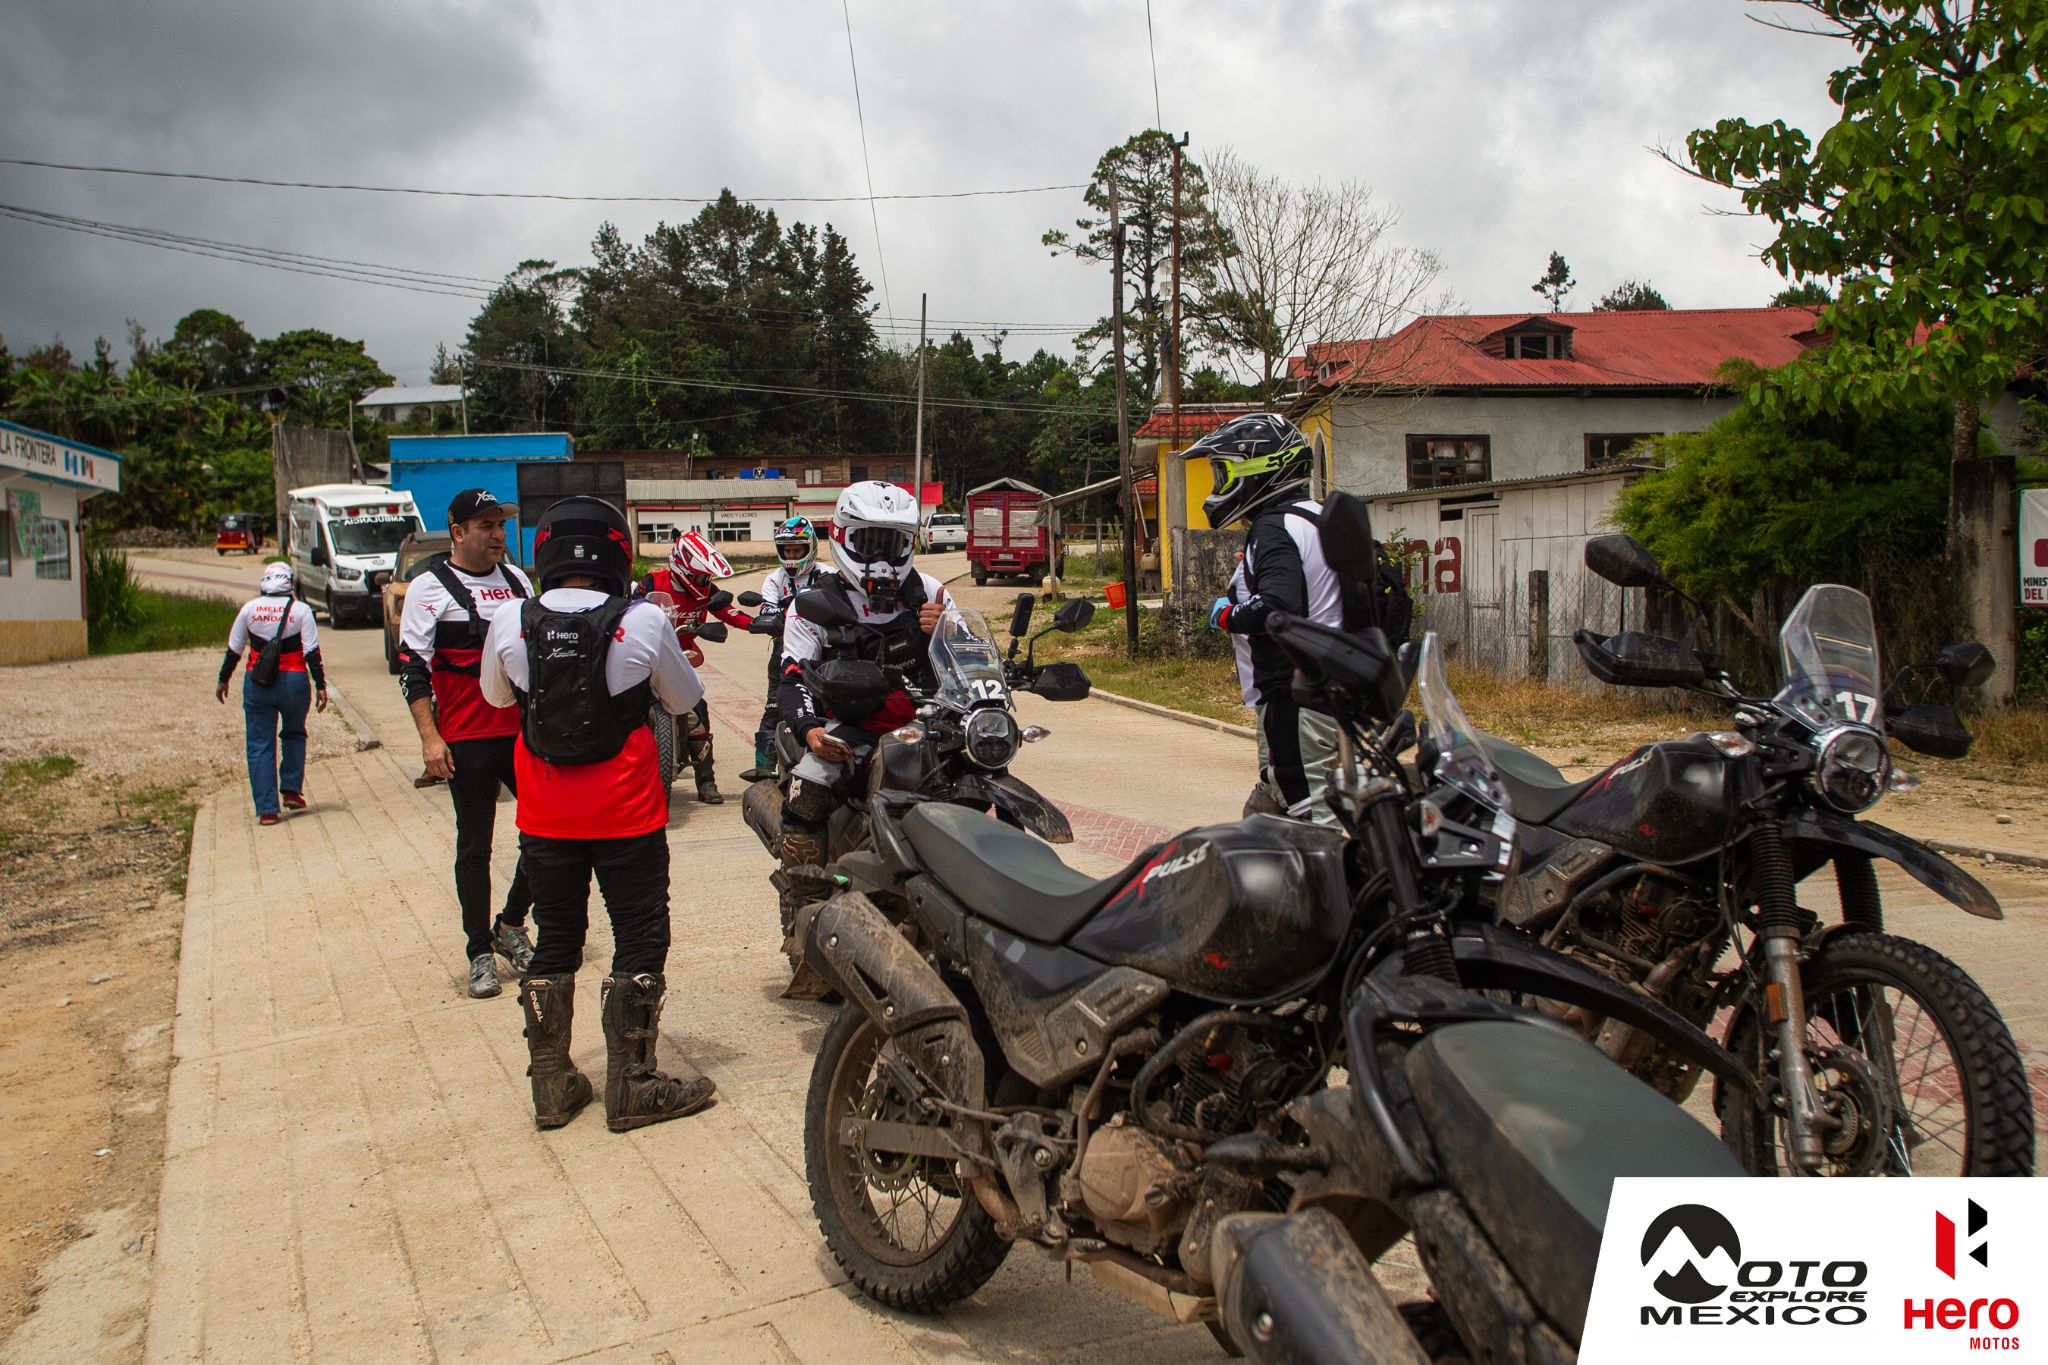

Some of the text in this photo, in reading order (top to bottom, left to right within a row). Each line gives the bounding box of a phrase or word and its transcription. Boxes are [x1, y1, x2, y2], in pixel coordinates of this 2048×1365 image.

[0, 431, 57, 466] LA FRONTERA
[2024, 588, 2044, 600] DEL
[256, 605, 287, 613] IMELD
[251, 614, 295, 623] SANDAE
[556, 631, 579, 640] Hero
[971, 680, 1006, 699] 12
[1835, 691, 1877, 724] 17
